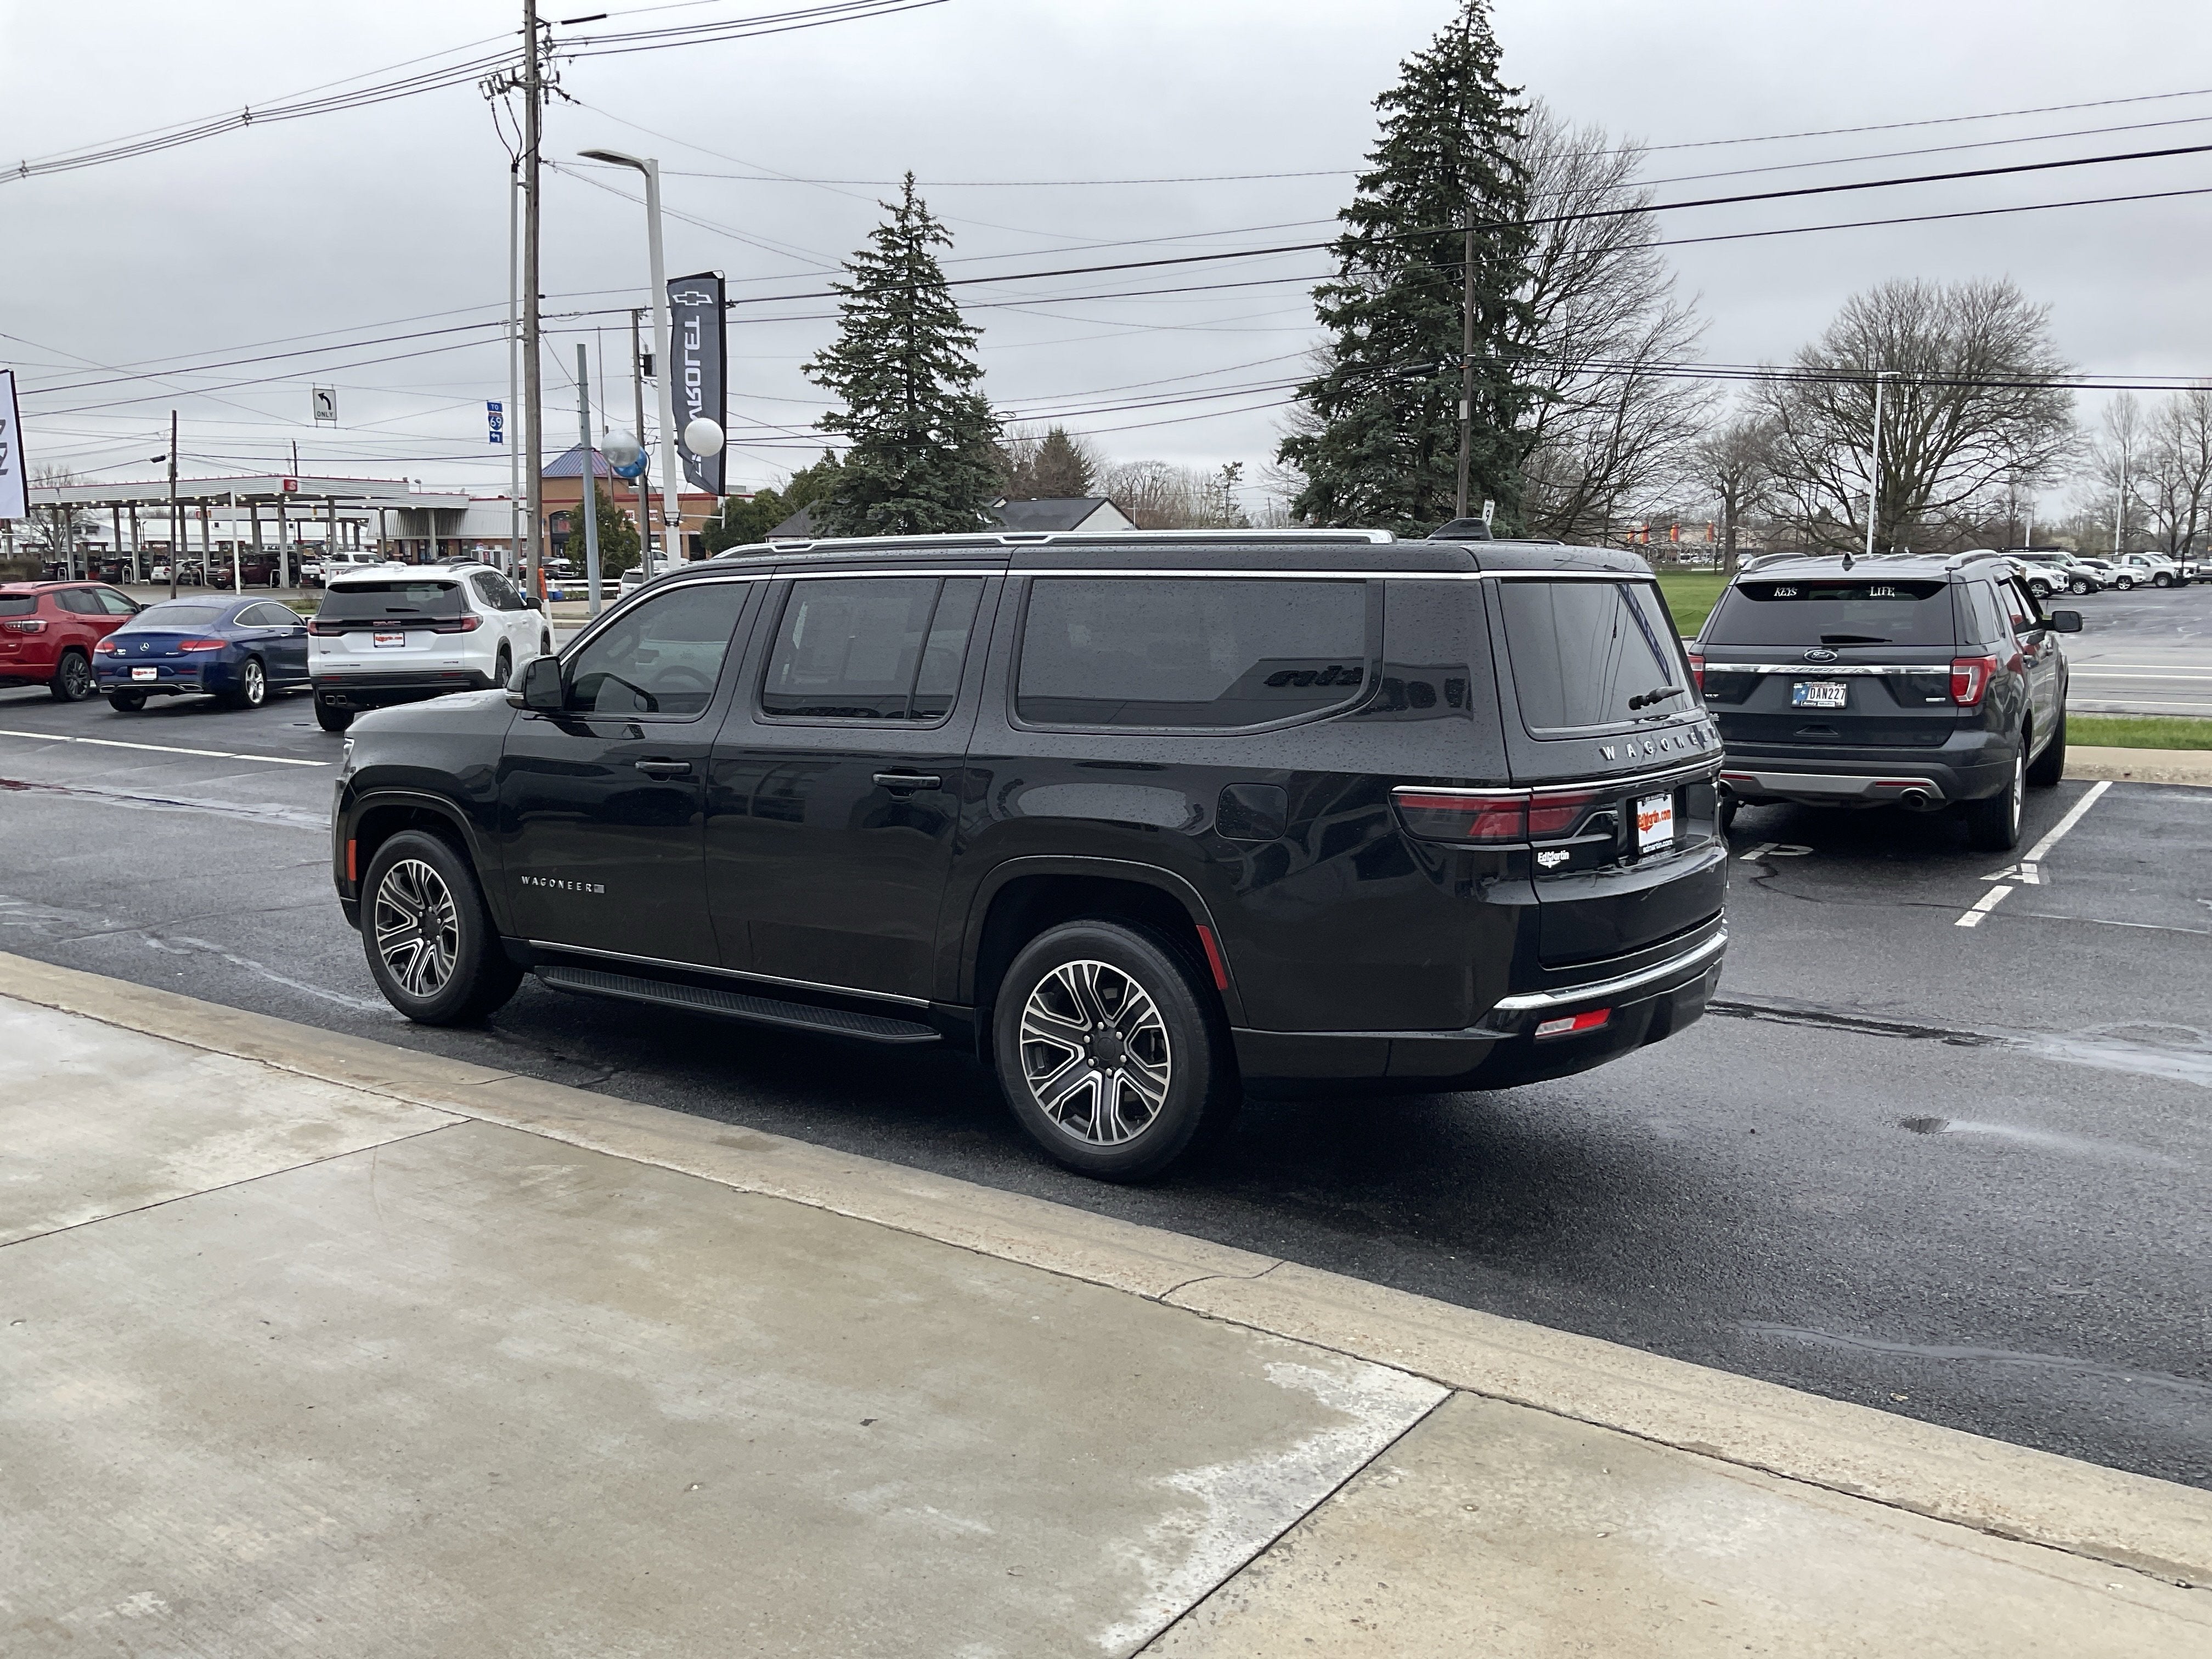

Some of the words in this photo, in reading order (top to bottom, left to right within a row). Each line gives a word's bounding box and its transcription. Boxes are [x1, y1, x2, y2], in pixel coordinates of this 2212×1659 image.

[490, 417, 501, 427] 69
[1486, 510, 1490, 522] 9
[1870, 586, 1895, 597] LIFE
[1810, 687, 1846, 699] DAN227
[521, 876, 592, 892] WAGONEER
